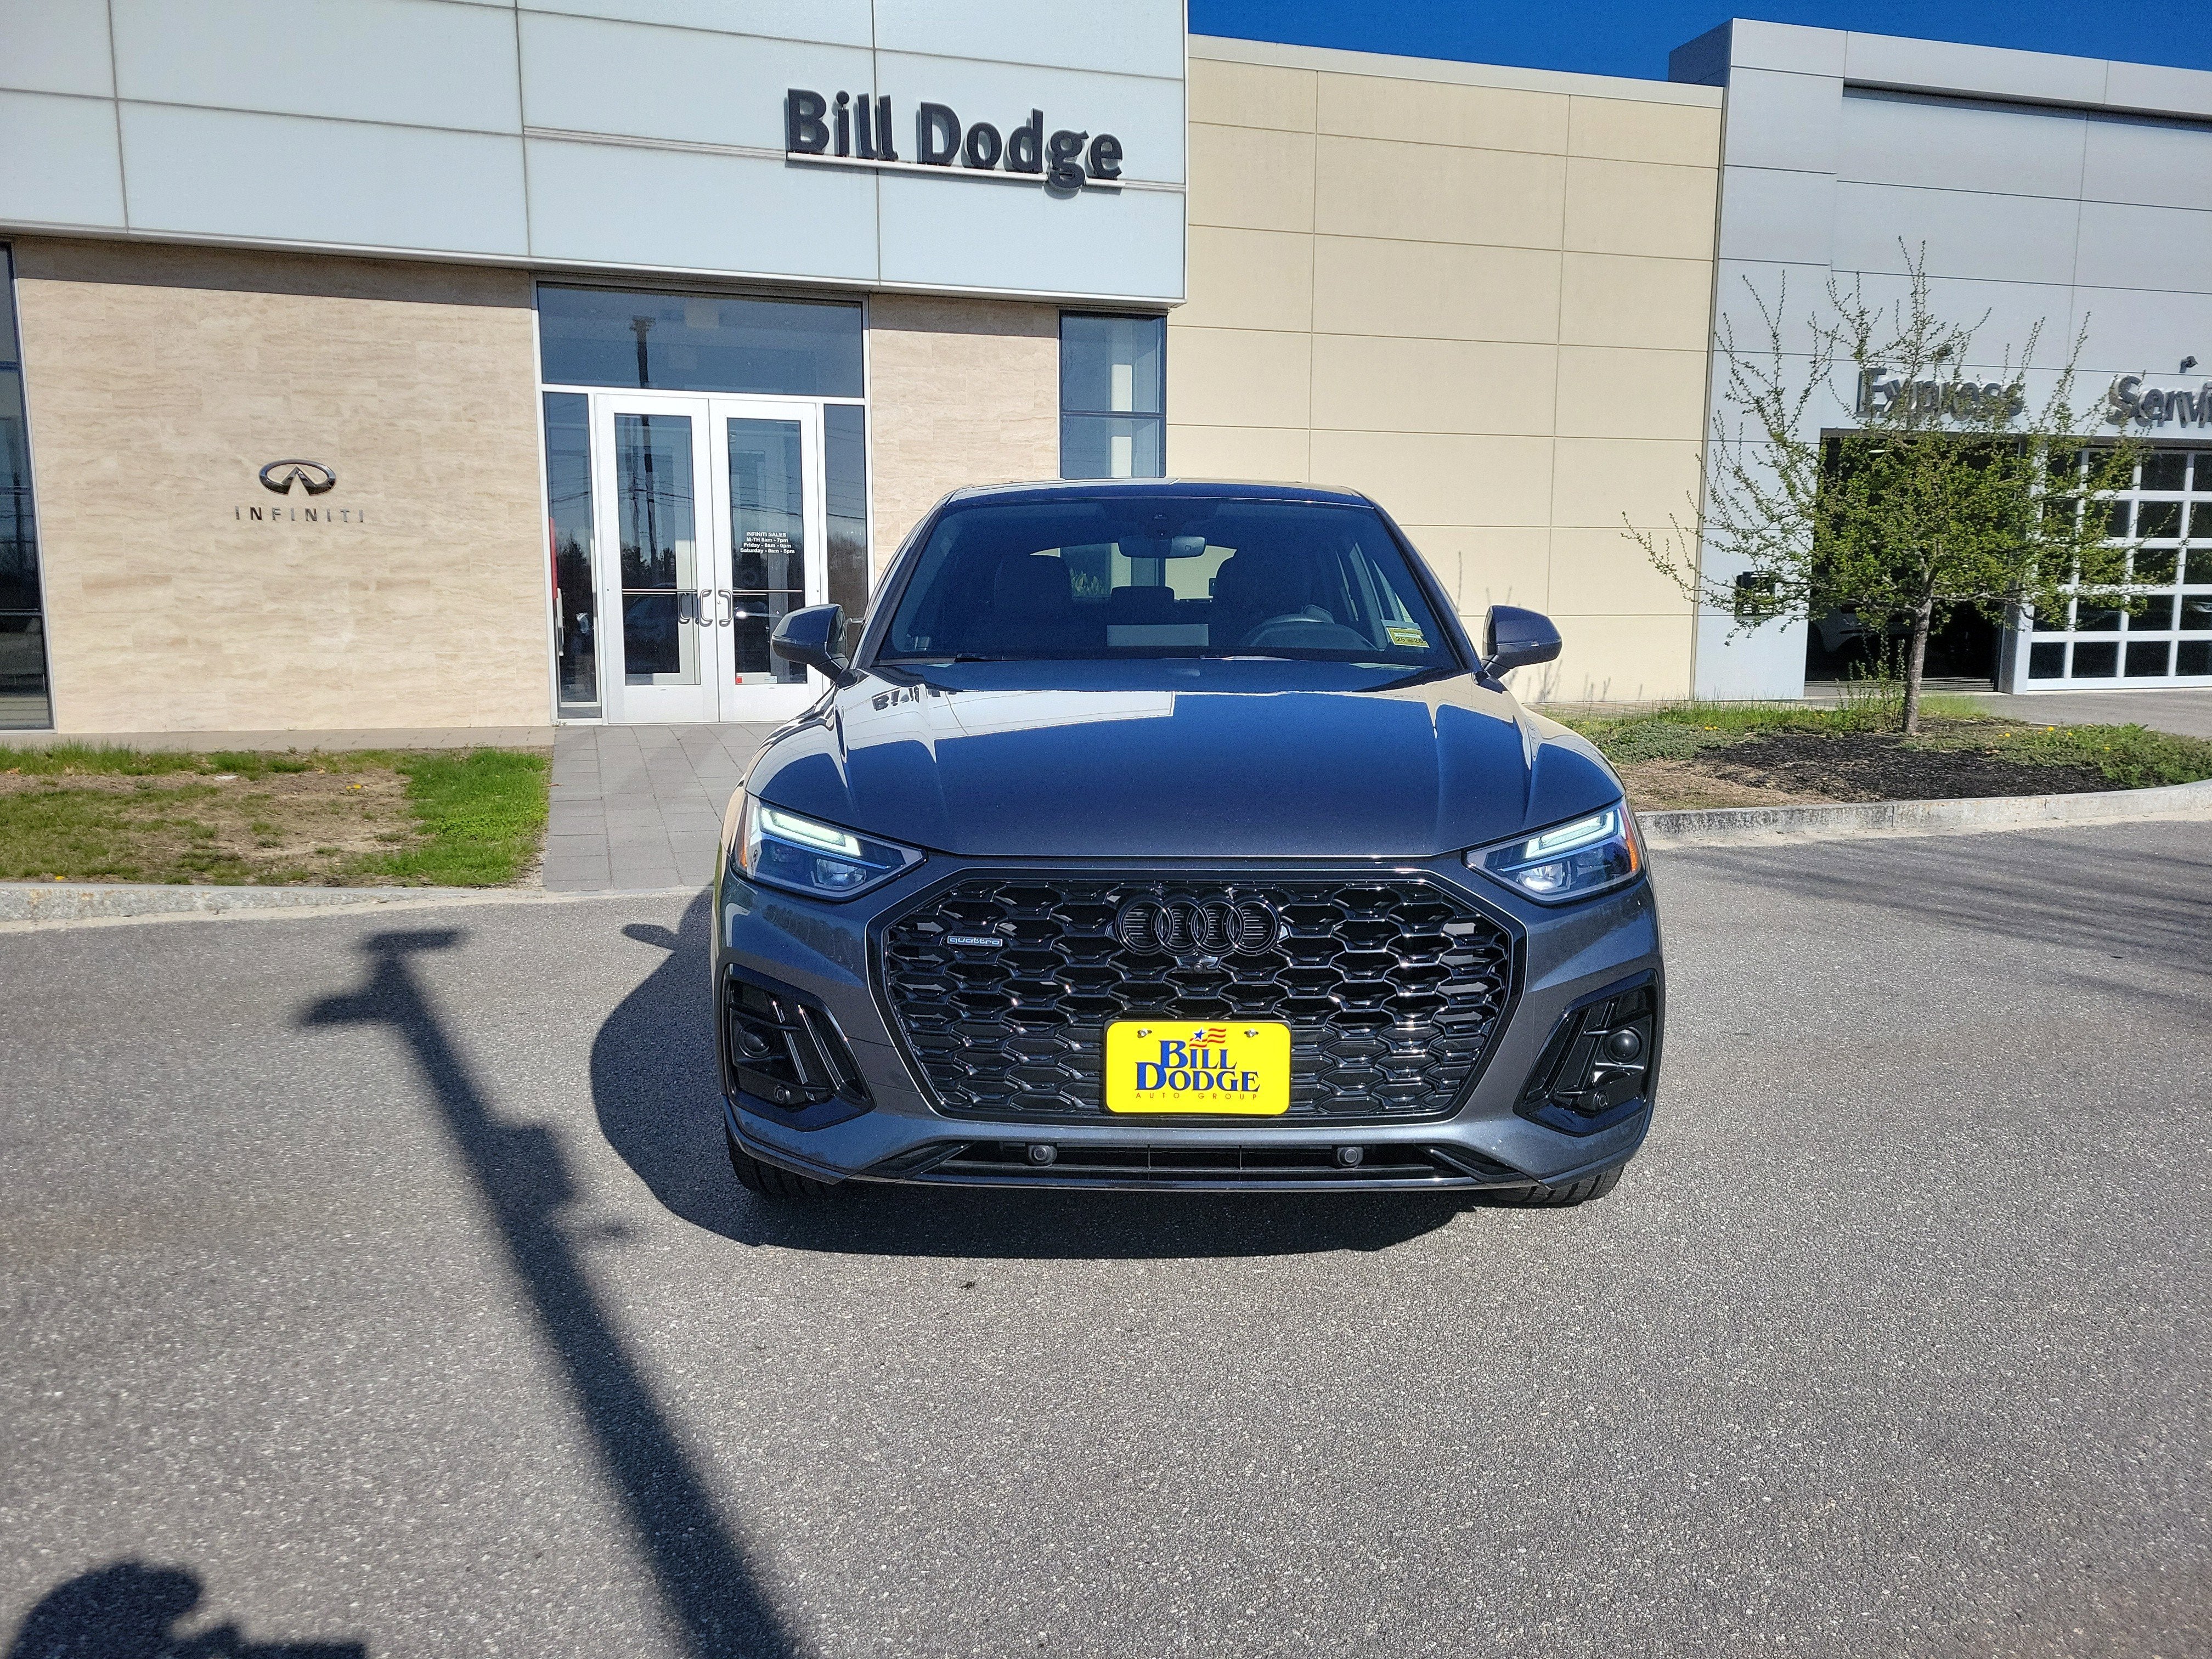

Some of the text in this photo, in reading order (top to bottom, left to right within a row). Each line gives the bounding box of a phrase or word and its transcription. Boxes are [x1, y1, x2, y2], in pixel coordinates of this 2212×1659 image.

[786, 88, 1124, 190] Bill Dodge
[235, 506, 364, 522] INFINITI
[950, 937, 1000, 945] quattro
[1159, 1040, 1238, 1070] BILL
[1134, 1062, 1261, 1093] DODGE
[1198, 1092, 1257, 1101] GROUP
